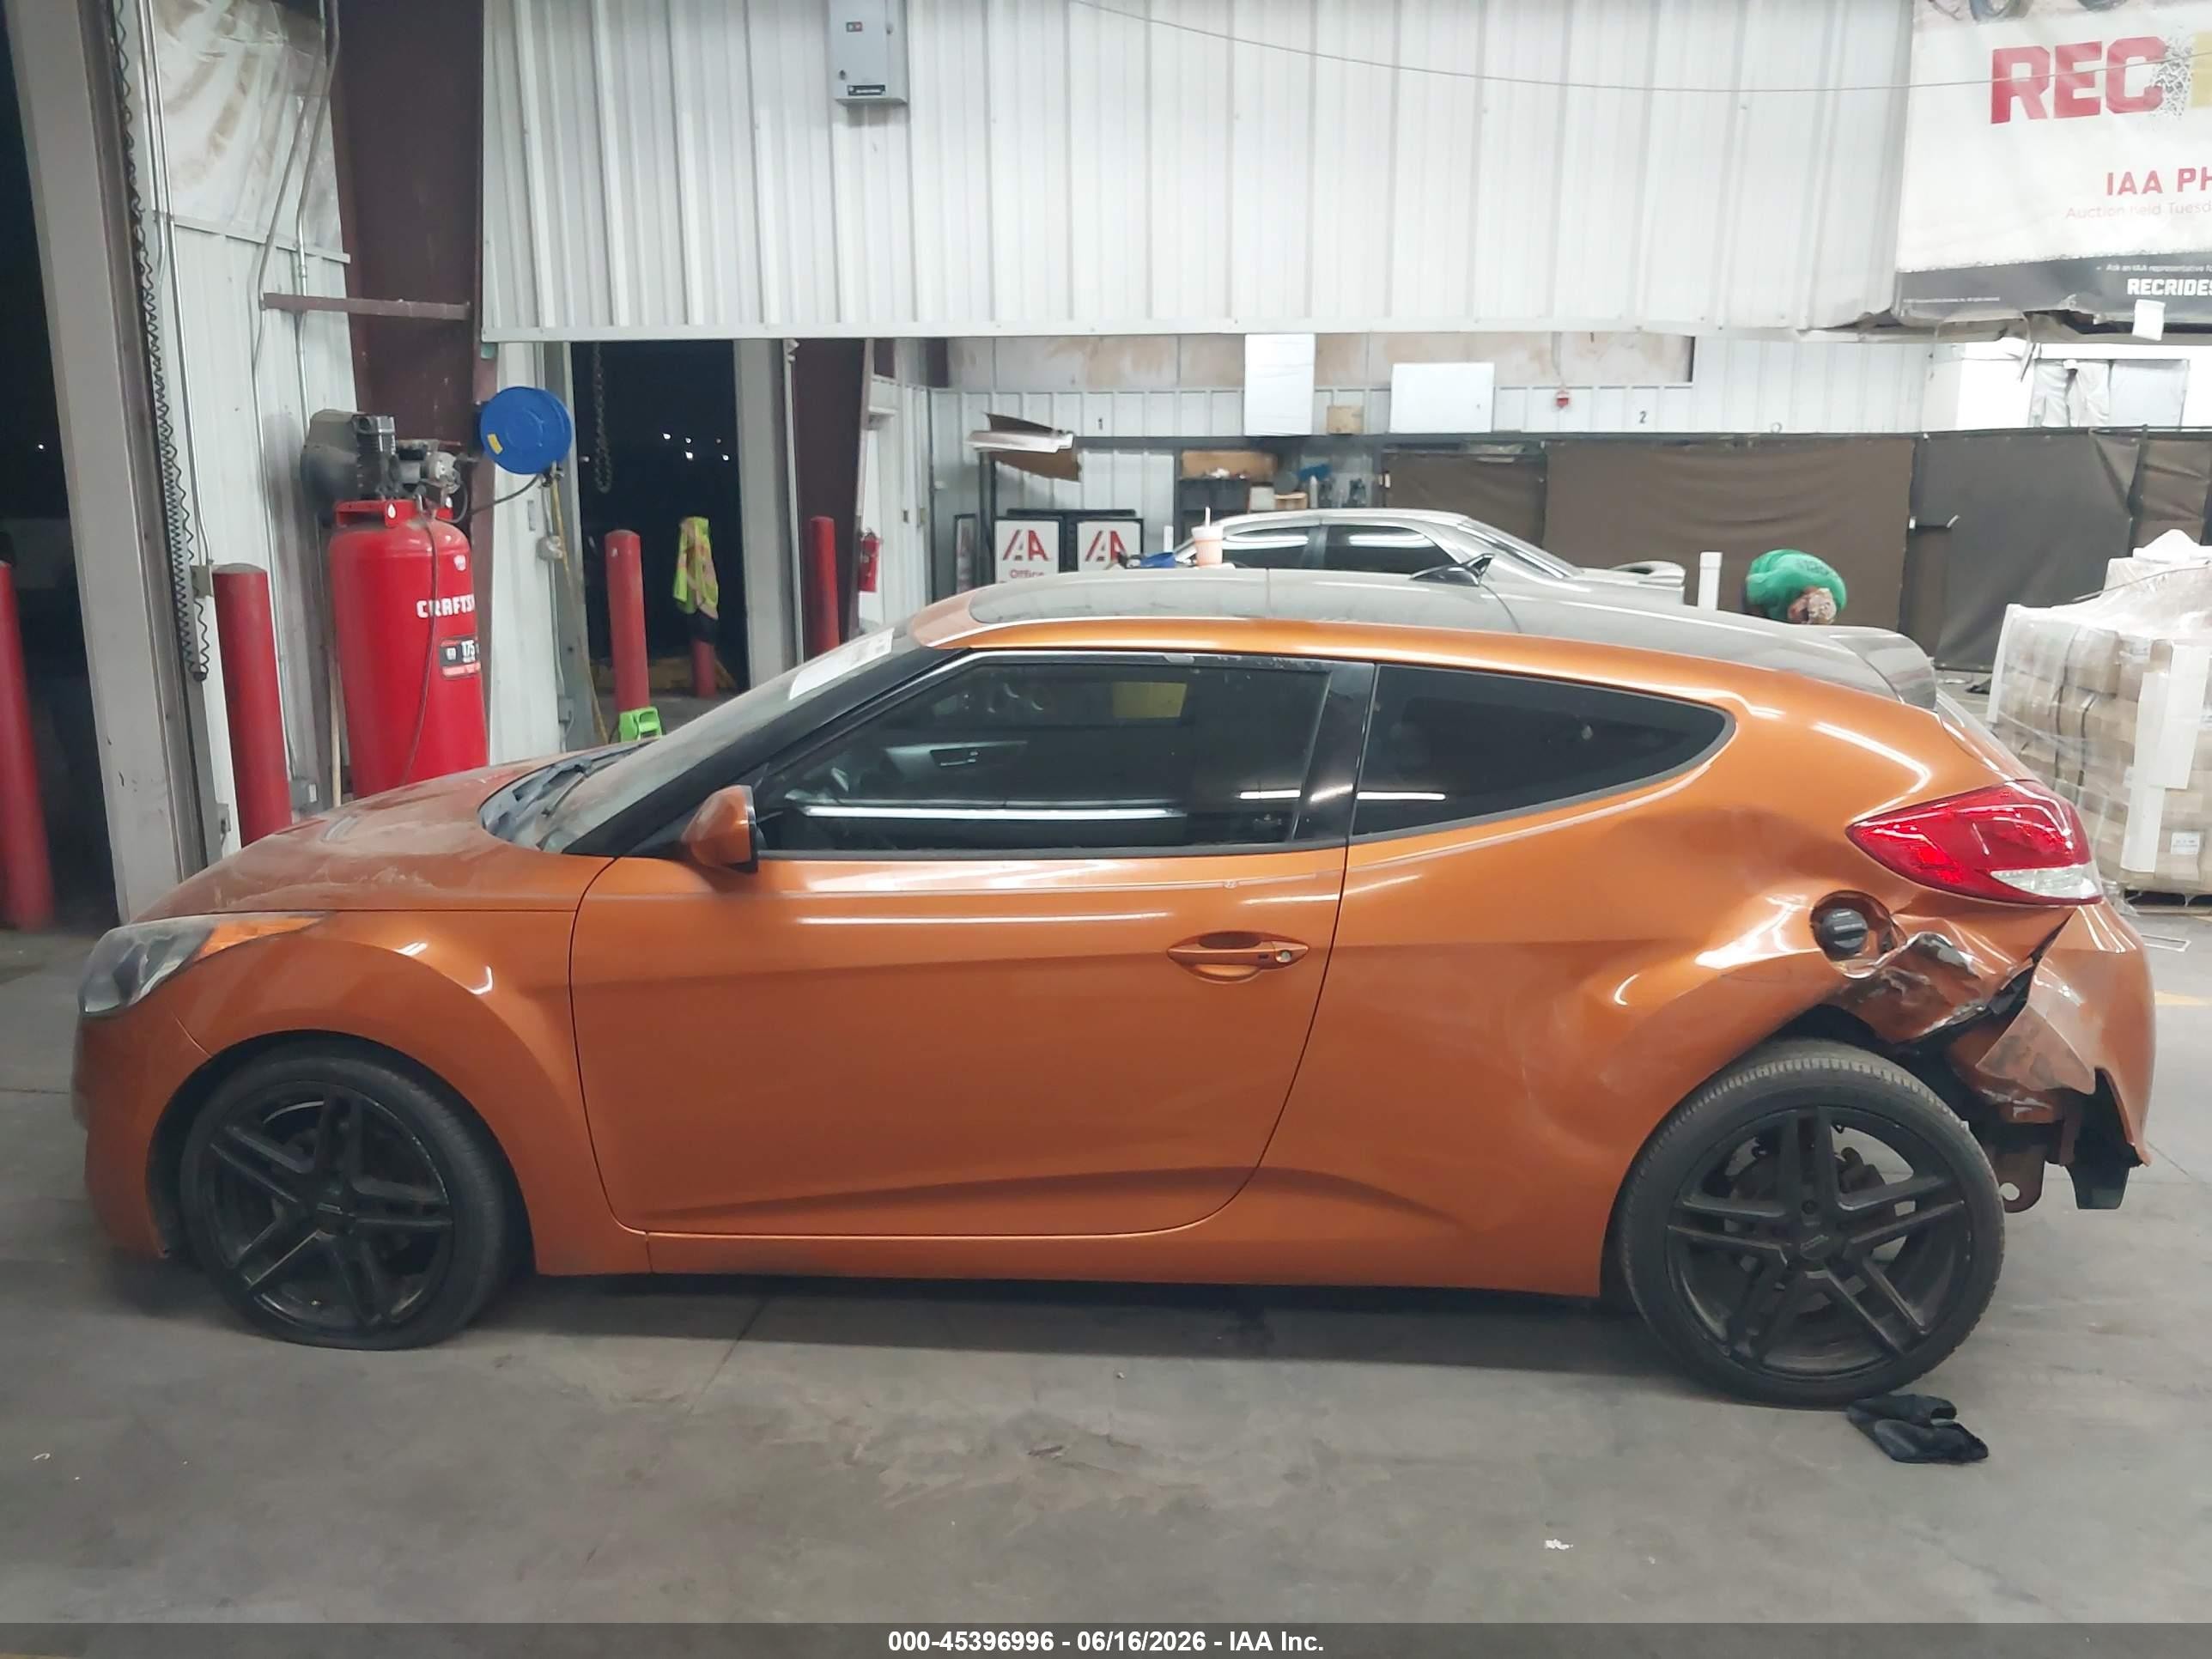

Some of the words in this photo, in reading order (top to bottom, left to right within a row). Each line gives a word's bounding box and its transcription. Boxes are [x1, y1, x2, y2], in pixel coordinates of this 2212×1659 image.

[1990, 36, 2166, 124] REC
[2107, 170, 2163, 196] IAA
[2177, 167, 2212, 192] PH
[2066, 208, 2124, 219] Auction
[1097, 417, 1103, 430] 1
[1639, 410, 1647, 424] 2
